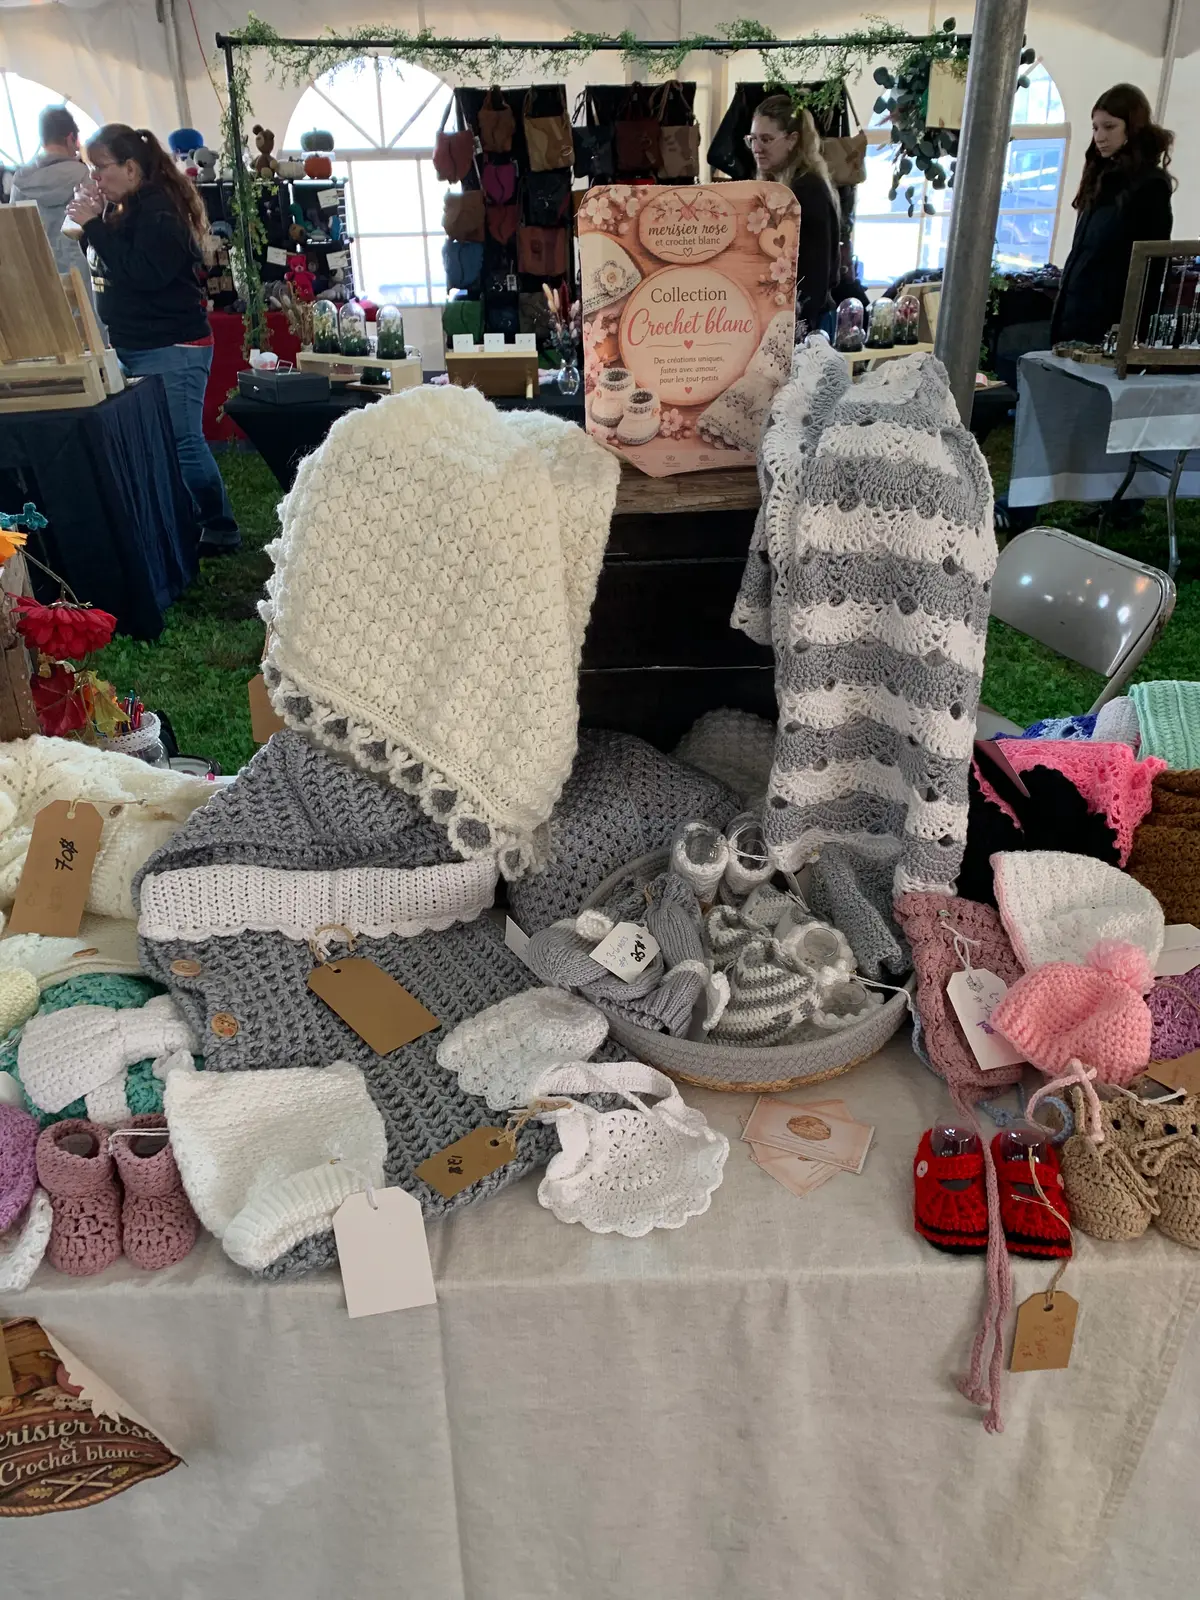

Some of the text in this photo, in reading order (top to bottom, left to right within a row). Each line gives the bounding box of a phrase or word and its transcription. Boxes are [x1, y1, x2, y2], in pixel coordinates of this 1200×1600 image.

[648, 224, 728, 236] merisier rose
[665, 237, 696, 246] crochet
[698, 236, 721, 245] blanc
[650, 287, 728, 303] Collection
[627, 306, 754, 346] Crochet blanc
[653, 355, 725, 365] Des créations uniques,
[660, 366, 678, 376] faites
[695, 365, 718, 373] amour,
[675, 375, 685, 383] les
[686, 374, 719, 383] tout-petits
[55, 837, 79, 871] 70$
[99, 1418, 160, 1442] rose
[59, 1436, 76, 1450] &
[86, 1445, 142, 1461] blanc
